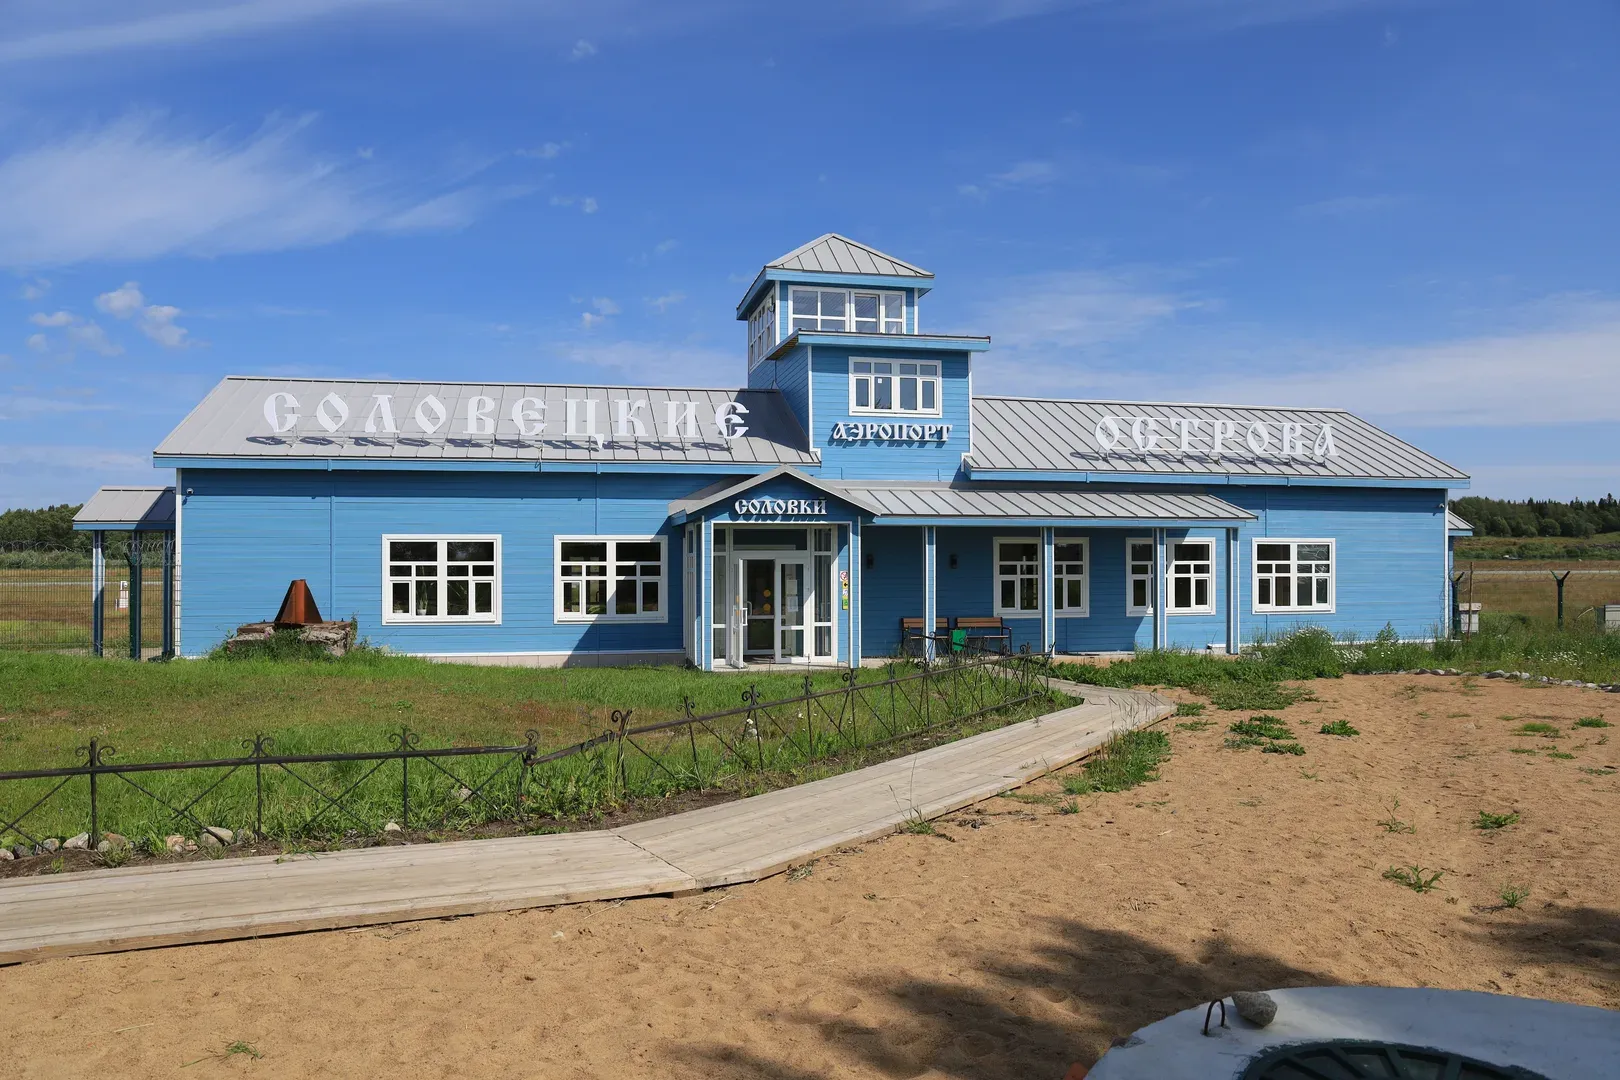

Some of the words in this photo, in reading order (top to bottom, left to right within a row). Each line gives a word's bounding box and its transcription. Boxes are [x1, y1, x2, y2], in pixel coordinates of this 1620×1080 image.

[263, 391, 750, 449] СОЛОВЕЦКИЕ
[832, 422, 953, 441] АЭРОПОРТ
[1095, 415, 1339, 456] ОСТРОВА
[734, 498, 828, 514] СОЛОВКИ
